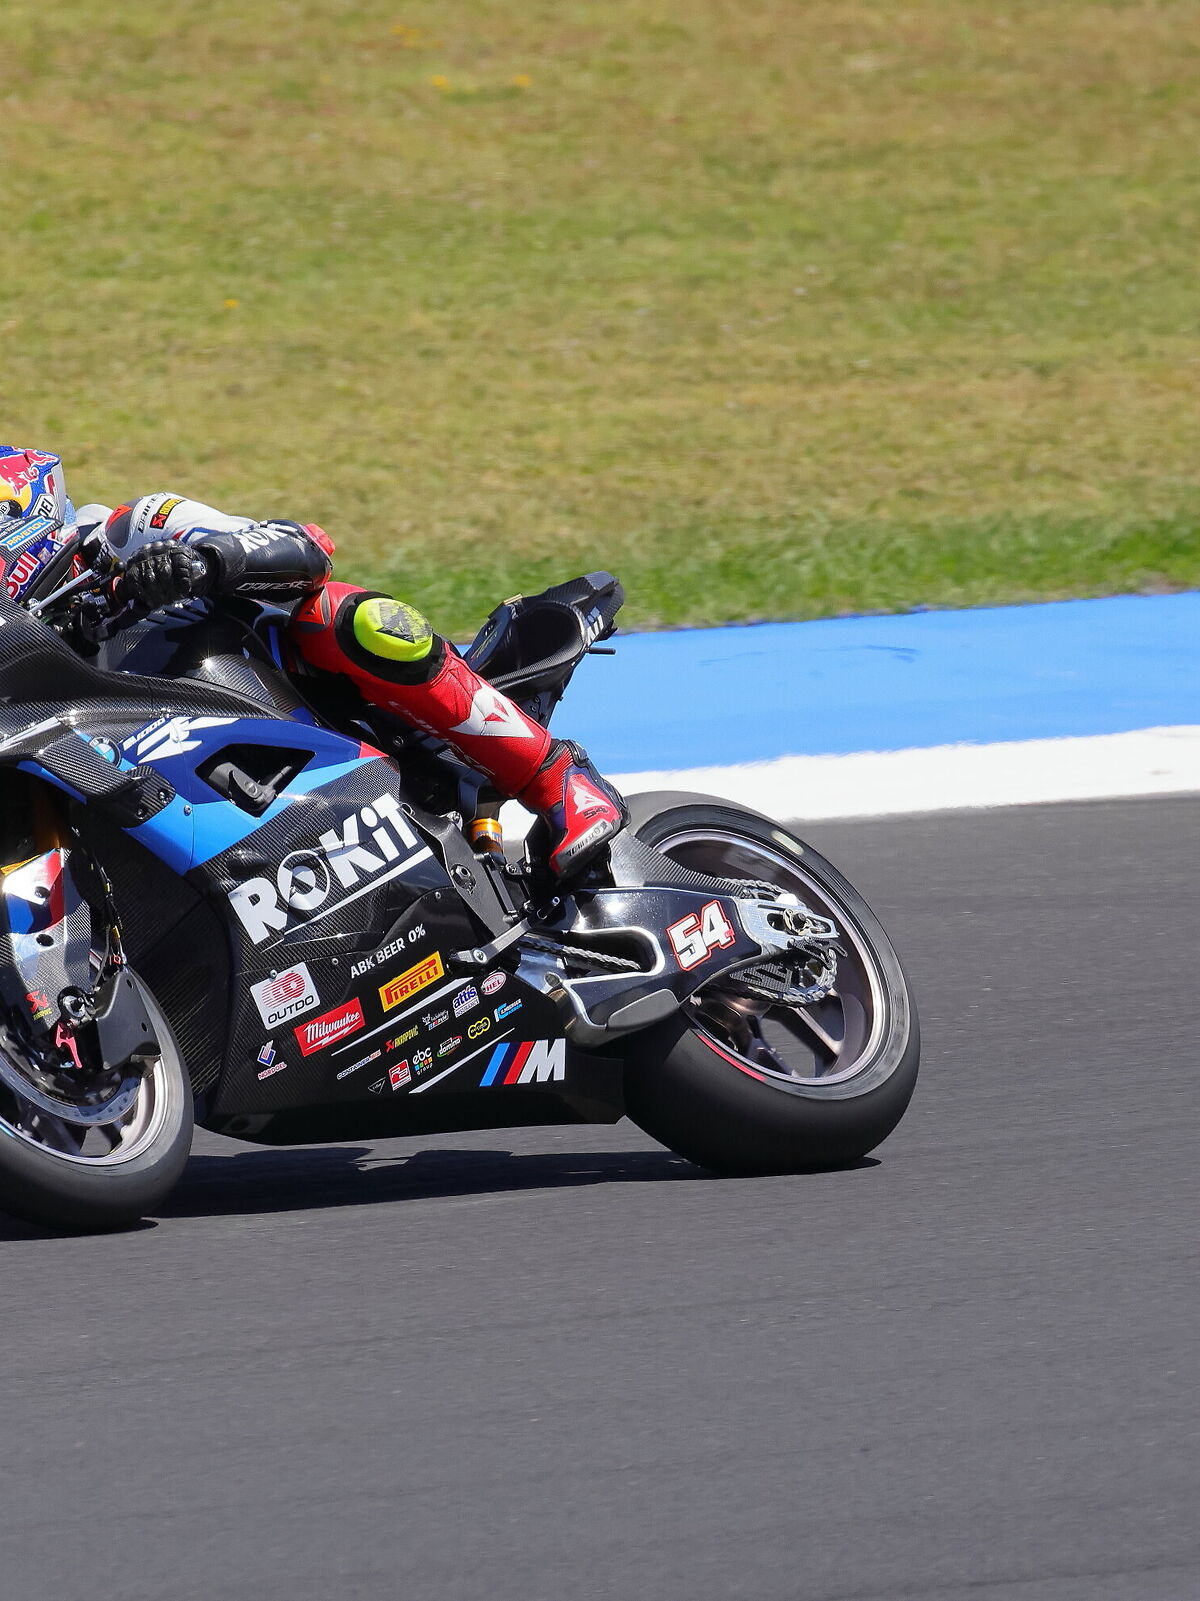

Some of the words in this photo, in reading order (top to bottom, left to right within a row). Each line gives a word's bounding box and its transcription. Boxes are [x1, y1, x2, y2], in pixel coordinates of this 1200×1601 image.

[6, 521, 45, 546] RAVENOL
[666, 900, 735, 970] 54
[350, 954, 376, 979] ABK
[375, 937, 405, 964] BEER
[408, 923, 426, 943] 0%
[384, 958, 439, 1006] PIRELLI
[485, 979, 501, 992] HEL
[268, 995, 314, 1024] OUTDO
[453, 985, 477, 1009] attis
[303, 1011, 360, 1044] Milwaukee
[412, 1047, 432, 1065] ebc
[417, 1062, 433, 1076] group
